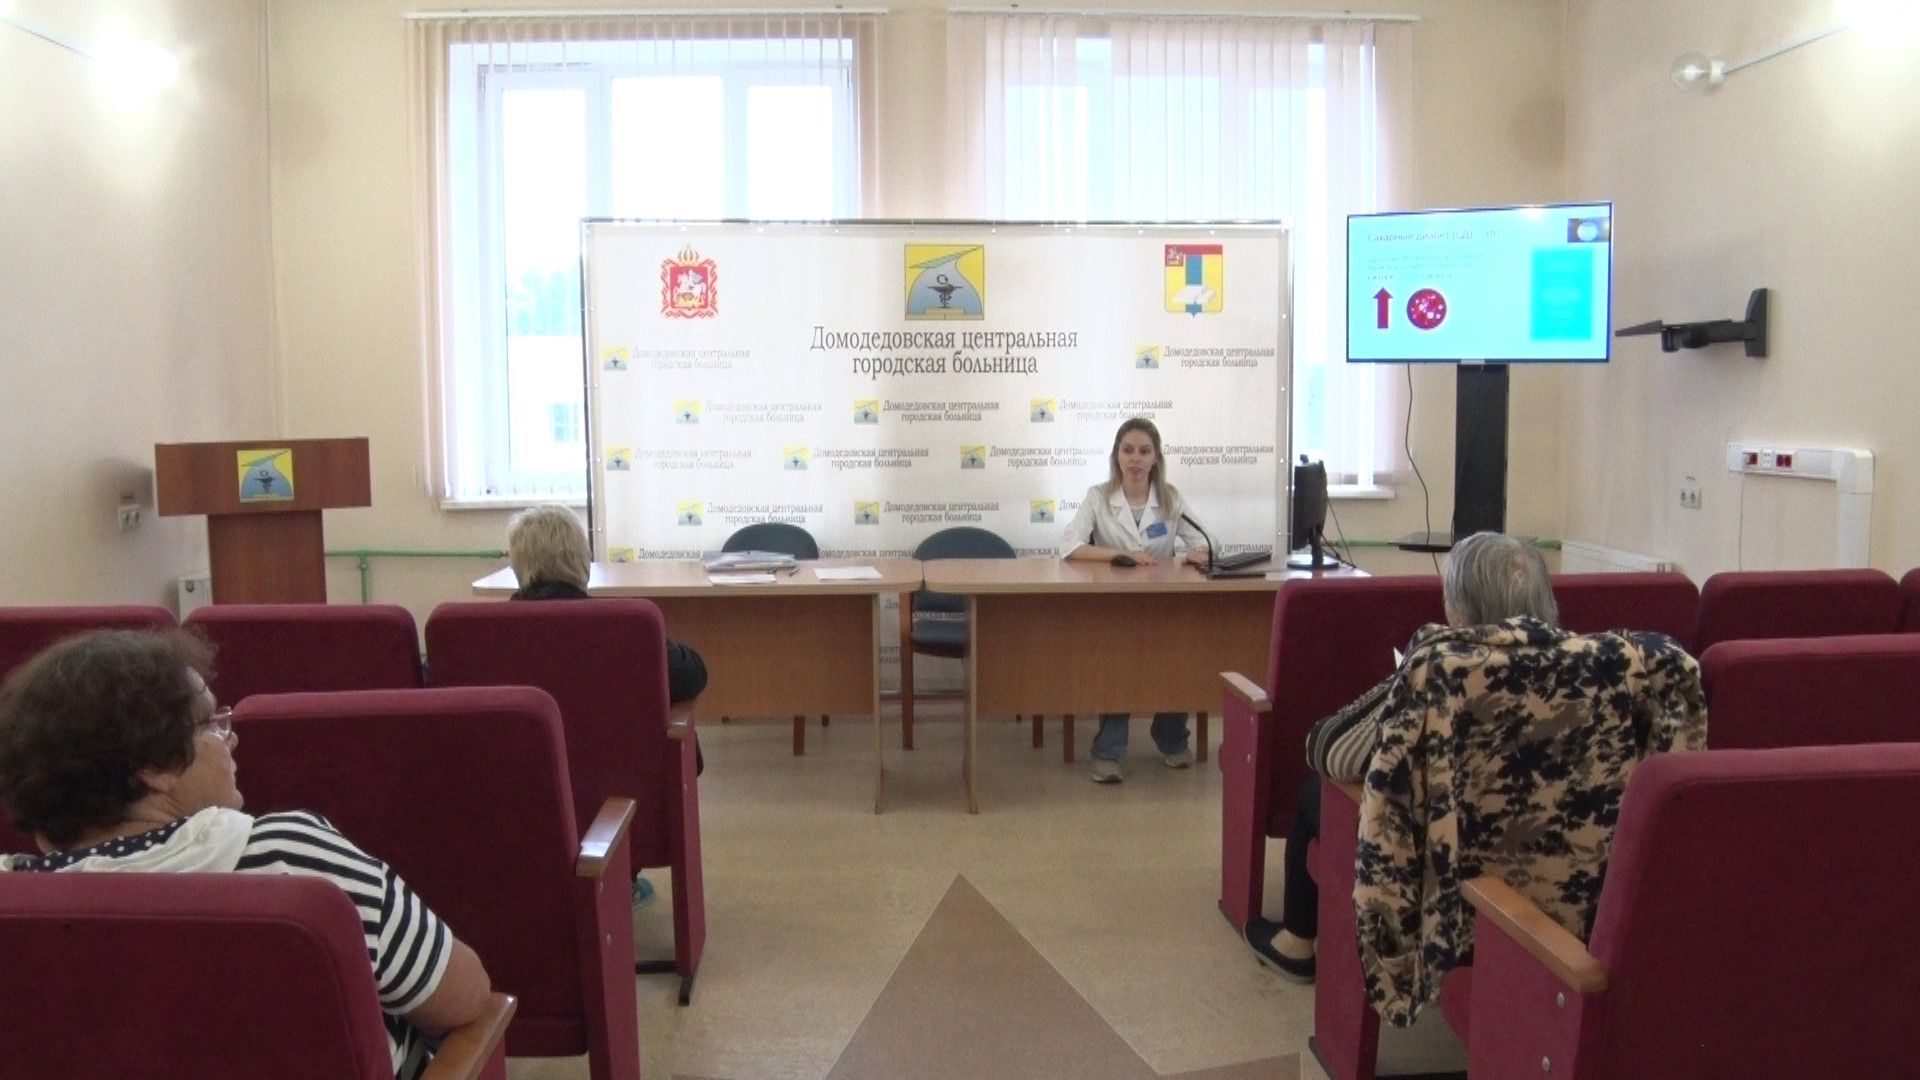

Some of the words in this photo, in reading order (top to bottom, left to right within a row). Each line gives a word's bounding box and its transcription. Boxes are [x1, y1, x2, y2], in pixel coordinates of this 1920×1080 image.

[810, 326, 955, 351] Домодедовская
[962, 330, 1078, 354] центральная
[1163, 346, 1223, 357] Домодедовская
[1225, 348, 1275, 359] центральная
[853, 355, 946, 380] городская
[953, 351, 1038, 375] больница
[1181, 358, 1220, 368] городская
[1222, 356, 1258, 367] больница
[883, 400, 946, 411] Домодедовская
[949, 401, 999, 413] центральная
[901, 413, 942, 424] городская
[944, 411, 982, 421] больница
[813, 446, 876, 458] Домодедовская
[878, 448, 929, 459] центральная
[1164, 444, 1223, 456] Домодедовская
[1226, 446, 1274, 456] центральная
[831, 459, 872, 471] городская
[874, 457, 912, 468] больница
[1180, 456, 1219, 467] городская
[1222, 454, 1257, 465] больница
[884, 501, 946, 513] Домодедовская
[949, 503, 999, 514] центральная
[902, 513, 942, 524] городская
[944, 511, 982, 522] больница
[638, 548, 700, 560] Домодедовская
[818, 548, 876, 559] омодедовская
